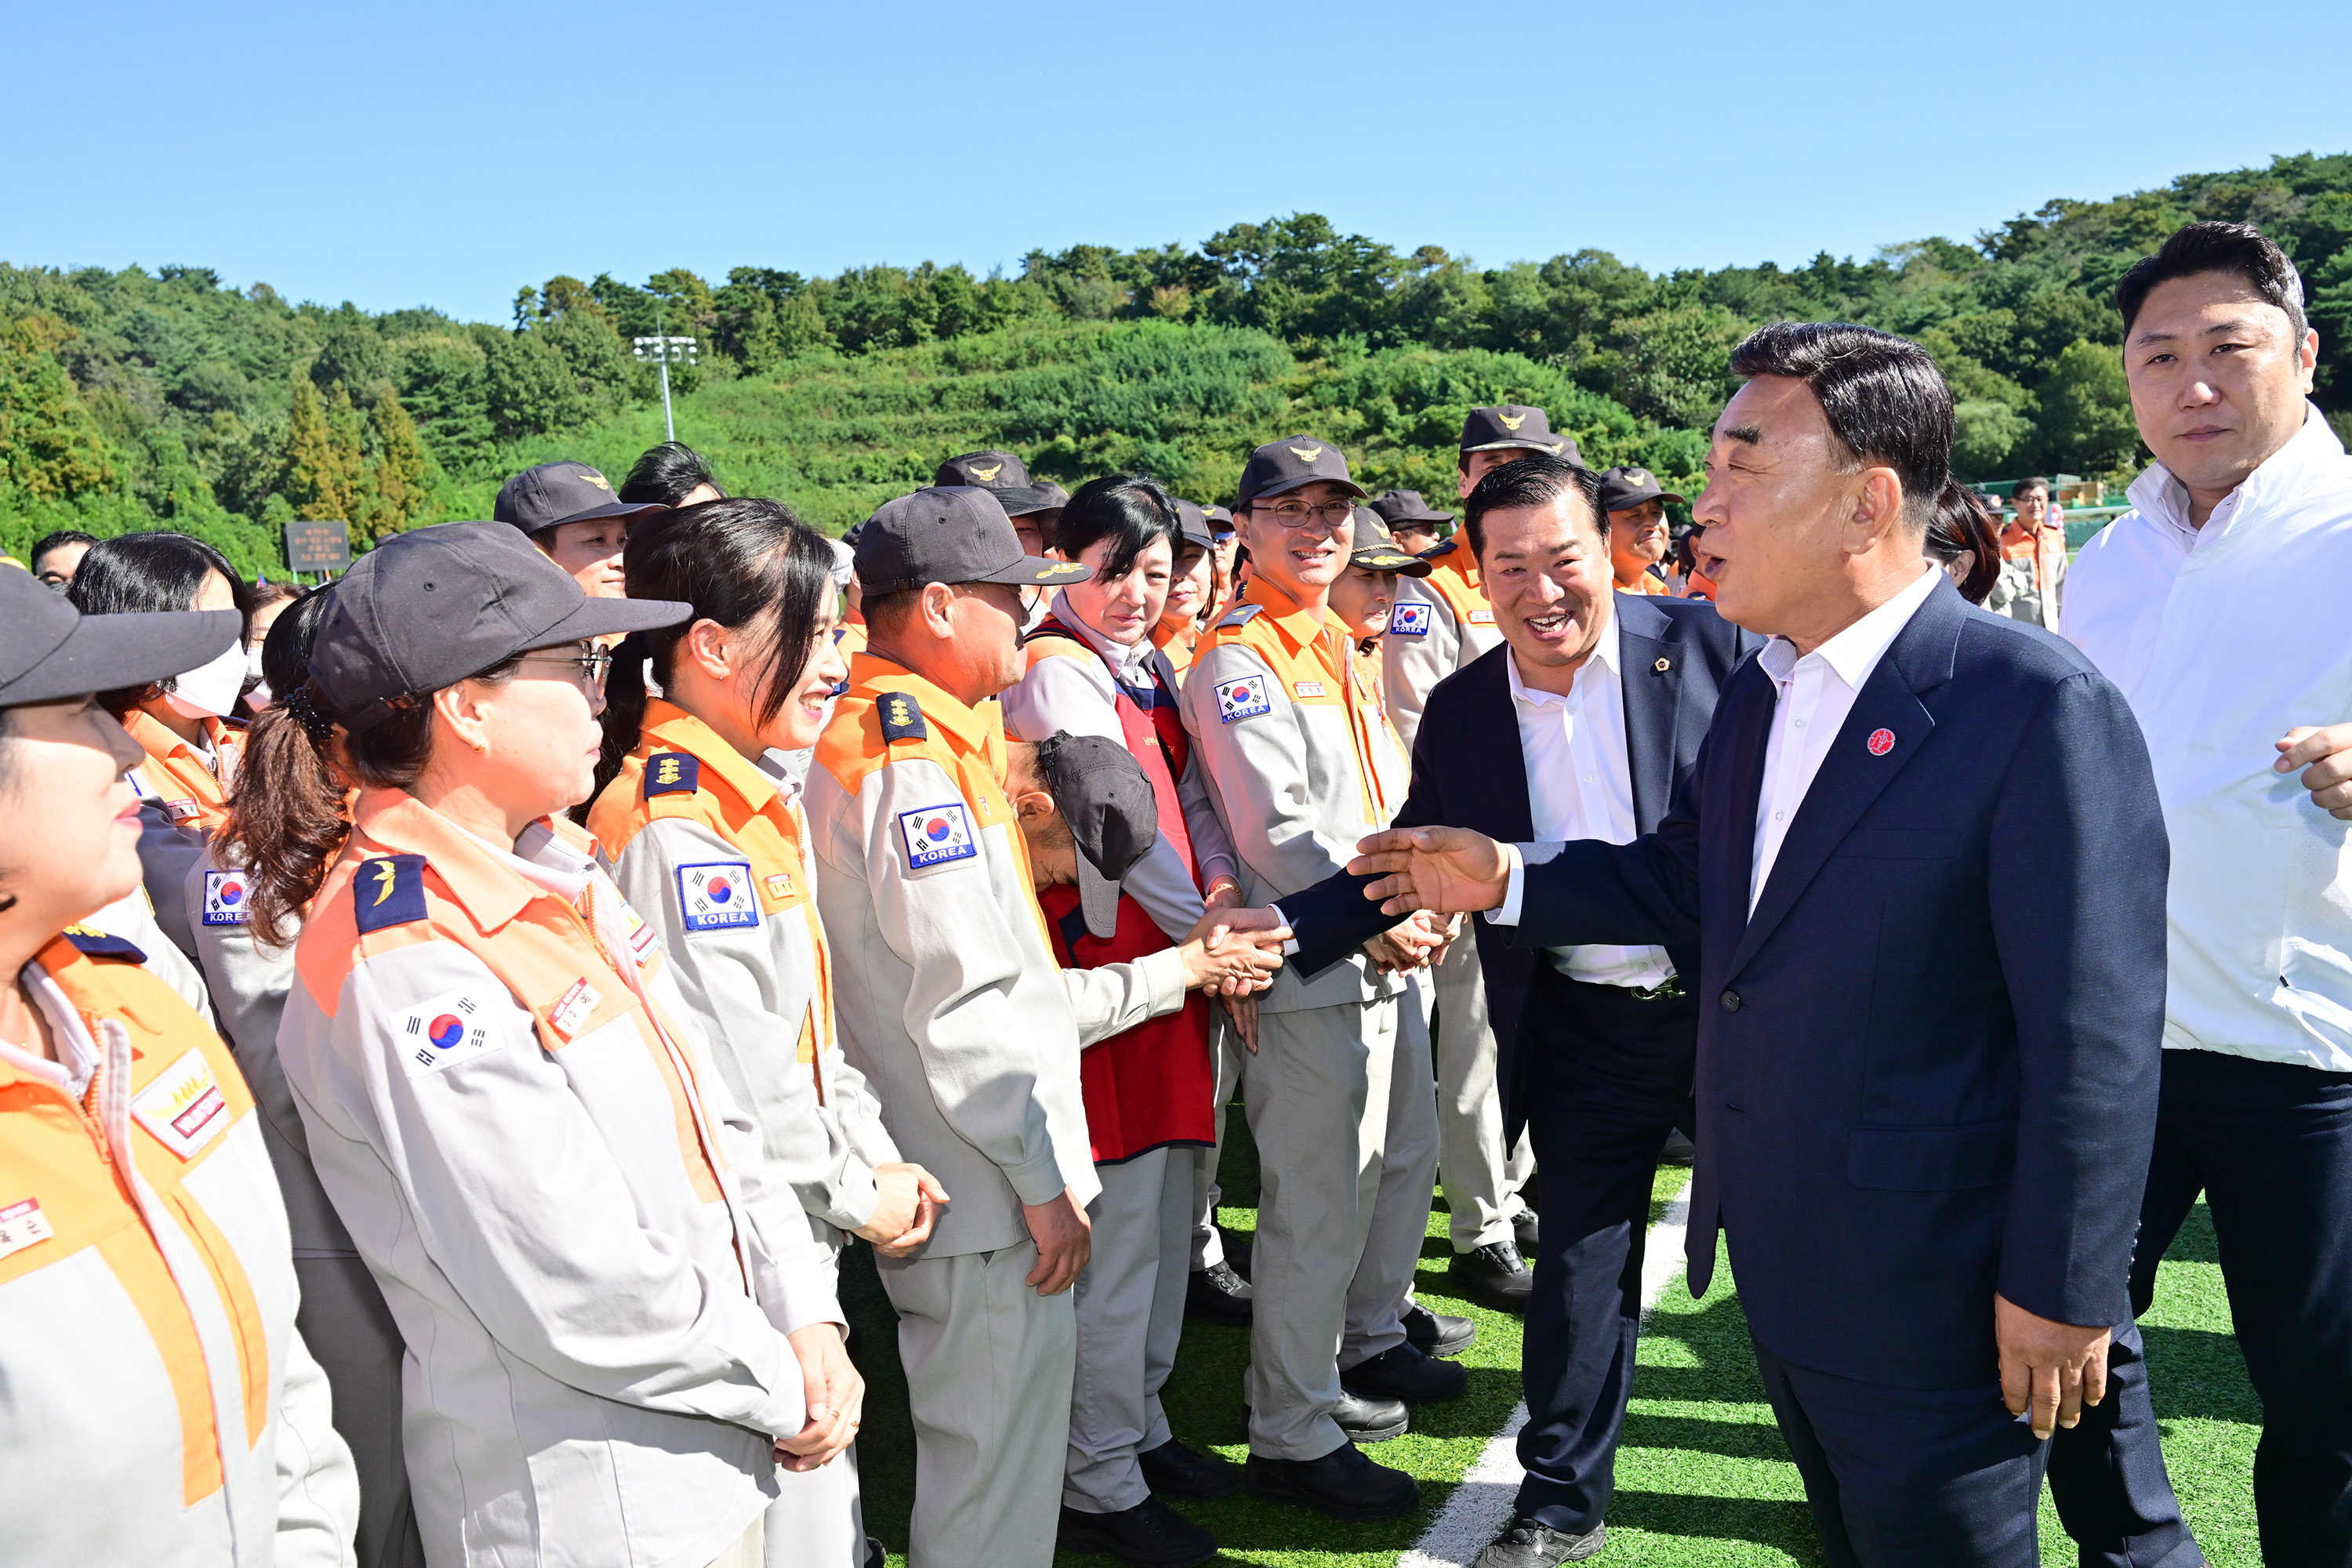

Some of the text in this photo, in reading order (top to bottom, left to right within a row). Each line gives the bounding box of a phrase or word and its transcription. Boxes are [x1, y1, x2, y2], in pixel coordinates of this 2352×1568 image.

[1227, 706, 1265, 720] KOREA
[919, 846, 967, 863] KOREA
[697, 912, 749, 925] KOREA
